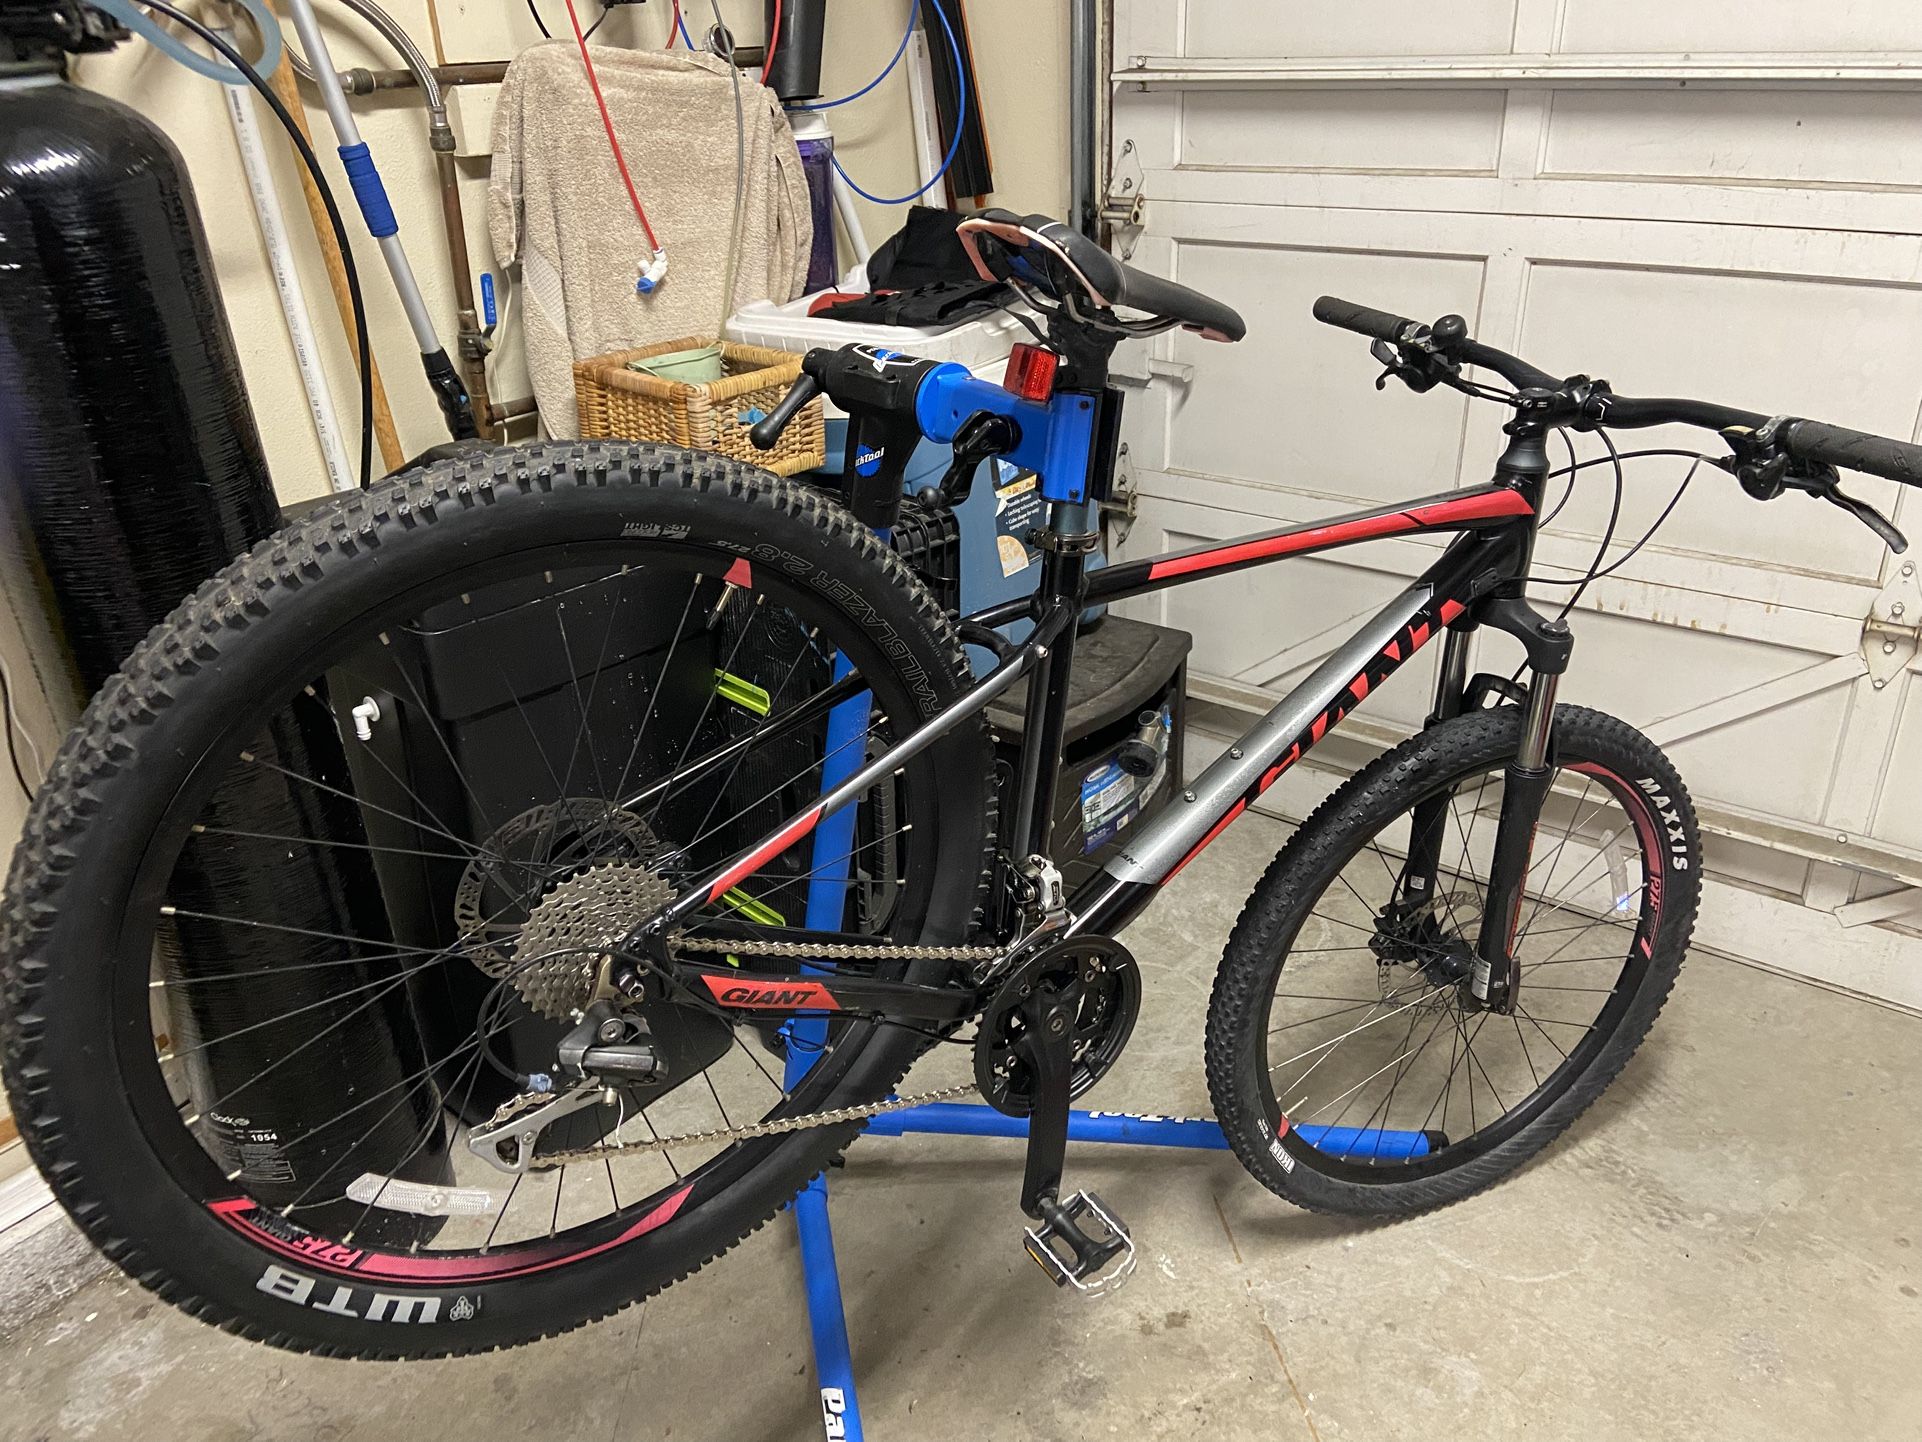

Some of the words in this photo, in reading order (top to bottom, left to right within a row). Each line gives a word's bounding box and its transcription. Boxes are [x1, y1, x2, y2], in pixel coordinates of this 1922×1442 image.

[809, 570, 944, 717] RAILBLAZER
[1635, 777, 1688, 870] MAXXIS
[721, 987, 818, 1005] GIANT
[250, 1132, 278, 1142] 1054
[1268, 1138, 1295, 1173] IKON
[256, 1264, 442, 1324] WTB
